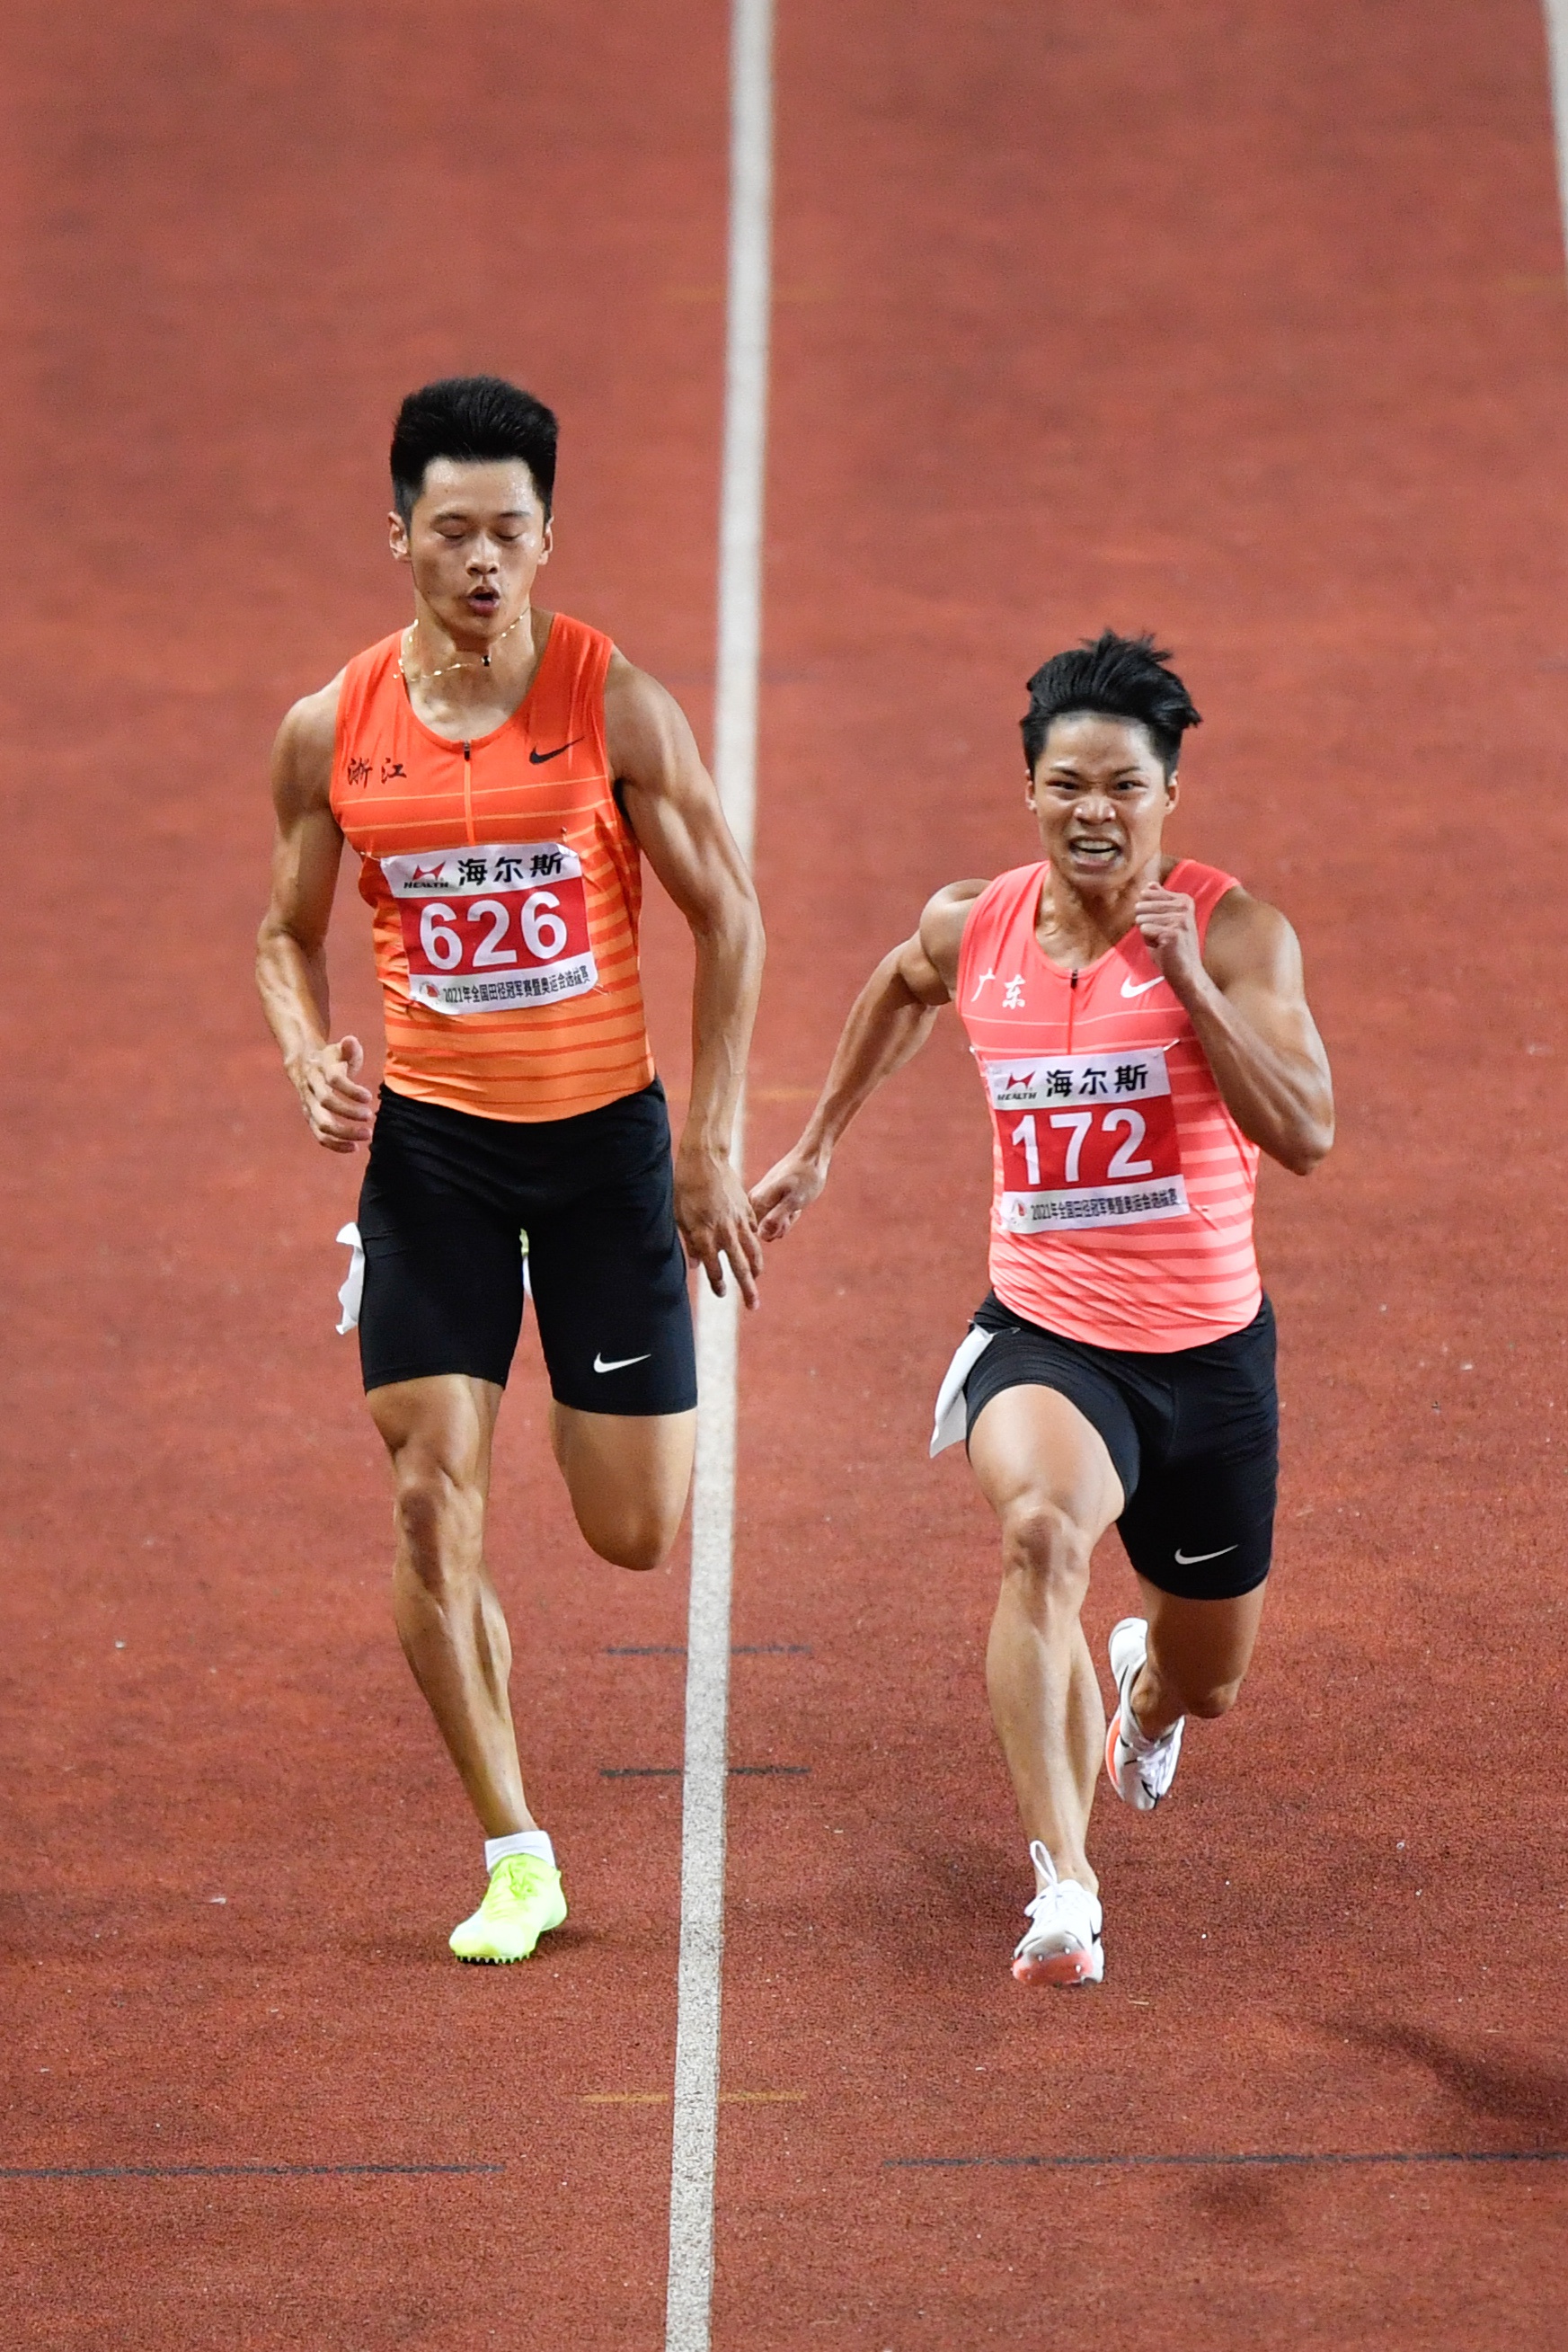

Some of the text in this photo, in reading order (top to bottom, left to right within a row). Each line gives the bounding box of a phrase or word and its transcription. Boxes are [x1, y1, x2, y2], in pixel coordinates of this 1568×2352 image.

[347, 757, 407, 788] 浙江
[457, 853, 563, 886] 海尔斯
[420, 891, 568, 970] 626
[970, 968, 1026, 1009] 广东
[997, 1092, 1037, 1101] HEALTH
[1046, 1064, 1148, 1098] 海尔斯
[1012, 1108, 1154, 1185] 172
